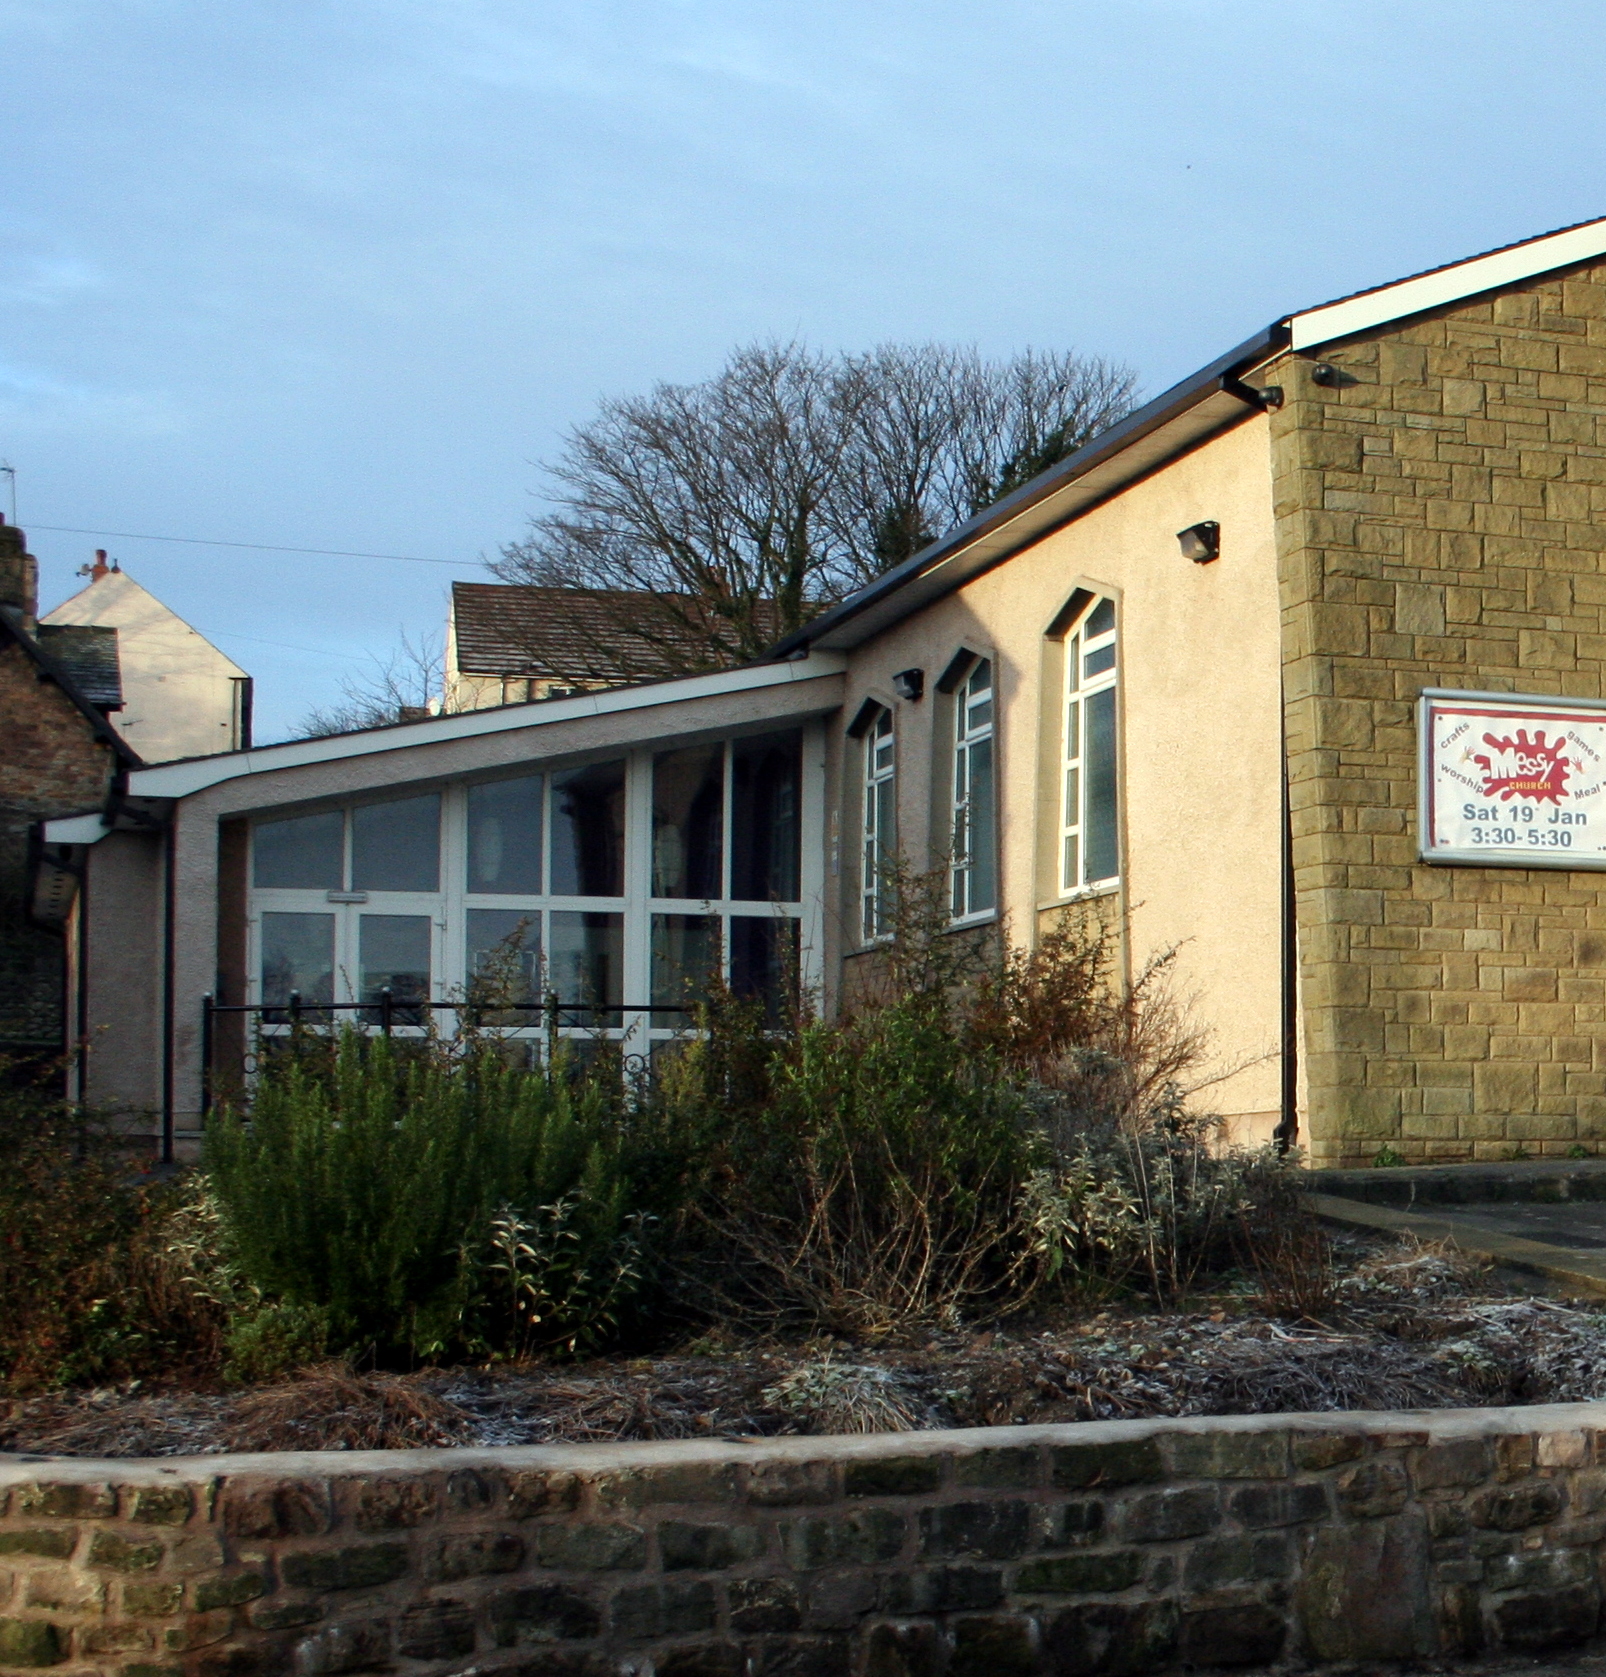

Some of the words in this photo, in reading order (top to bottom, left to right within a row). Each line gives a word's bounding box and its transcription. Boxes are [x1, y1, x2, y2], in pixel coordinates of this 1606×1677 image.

[1441, 722, 1470, 749] crafts
[1566, 731, 1601, 762] games
[1490, 747, 1555, 782] Messy
[1441, 763, 1484, 794] worship
[1509, 782, 1551, 790] CHURCH
[1574, 784, 1601, 800] Meal
[1463, 803, 1498, 821] Sat
[1509, 805, 1533, 823] 19
[1548, 808, 1587, 825] Jan
